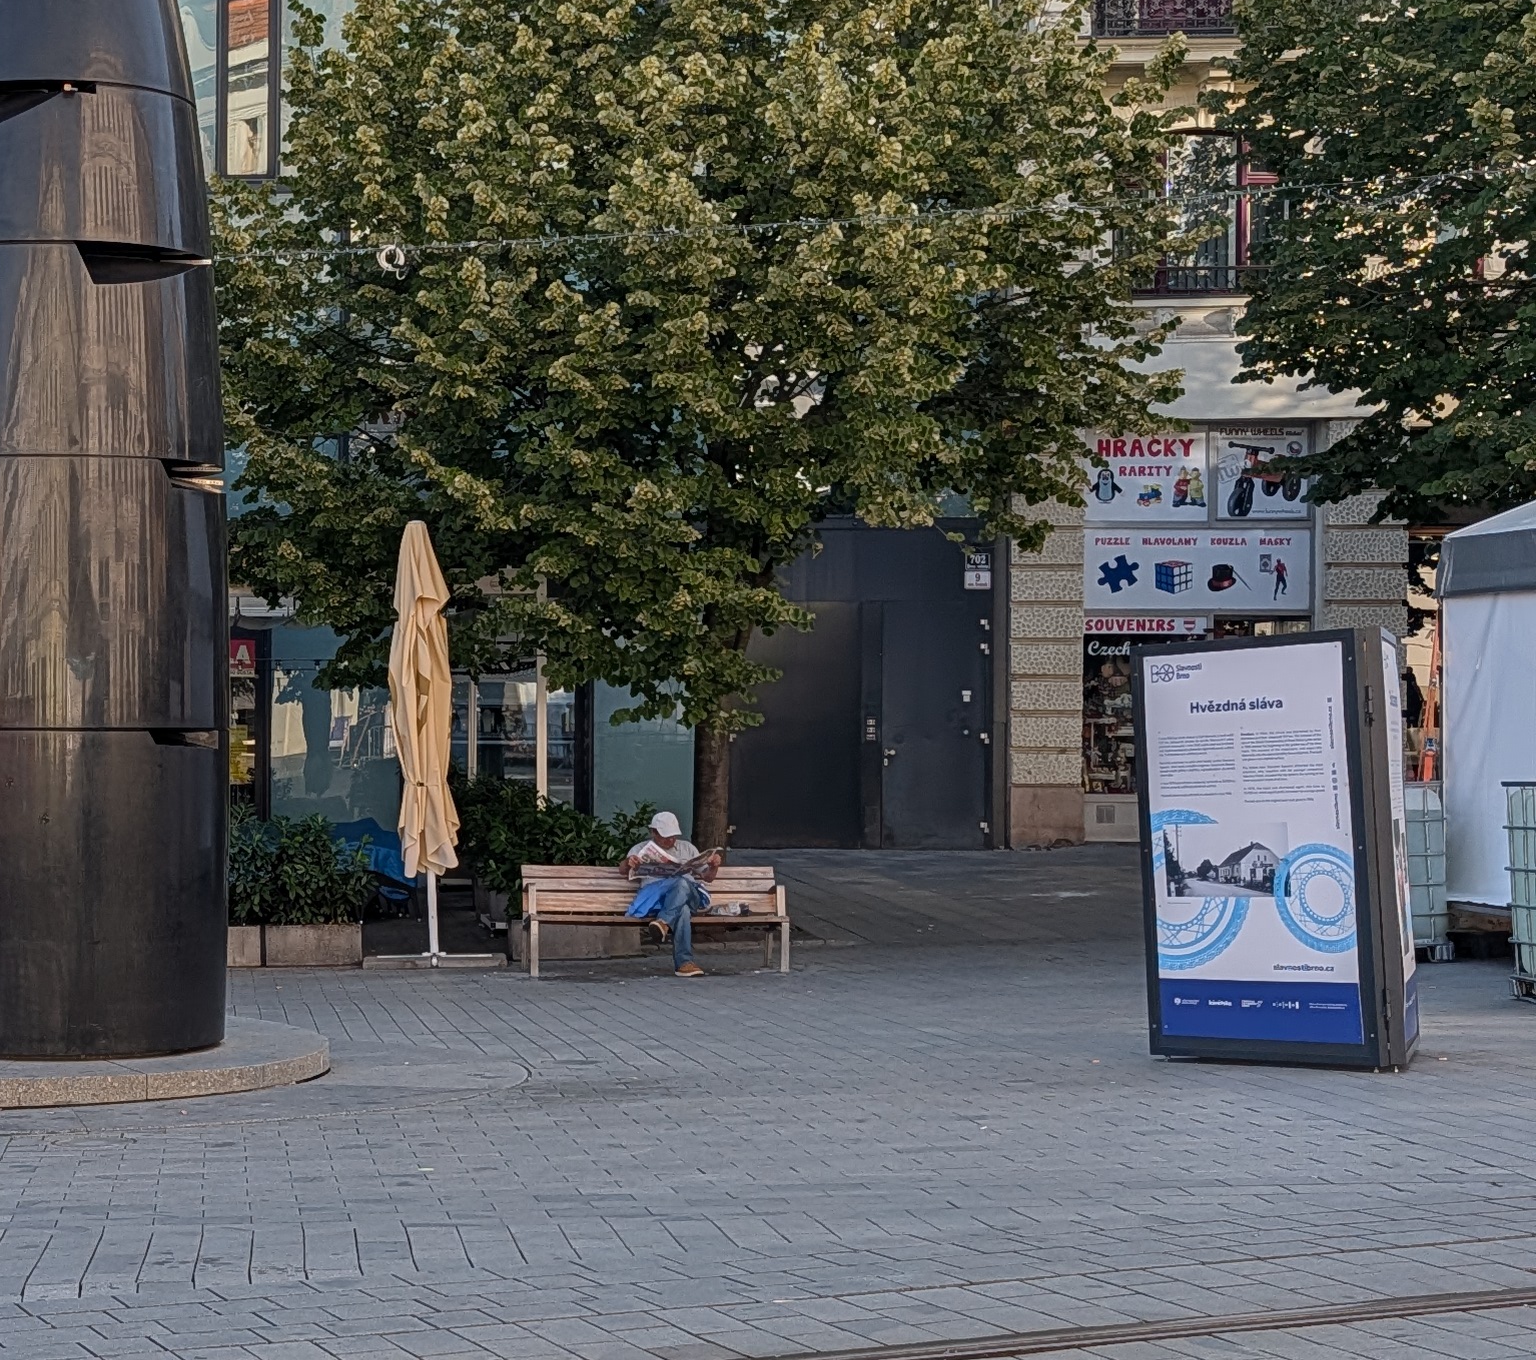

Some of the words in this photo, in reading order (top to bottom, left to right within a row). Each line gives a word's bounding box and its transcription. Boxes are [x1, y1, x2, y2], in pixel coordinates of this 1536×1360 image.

[1219, 428, 1249, 436] FUNNY
[1251, 428, 1284, 436] WHEELS
[1118, 465, 1173, 477] RARITY
[1094, 537, 1131, 546] PUZZLE
[1141, 536, 1198, 546] HLAVOLAMY
[1210, 536, 1247, 546] KOUZLA
[1259, 536, 1292, 546] MASKY
[969, 554, 987, 564] 702
[975, 572, 981, 582] 9
[1085, 618, 1176, 632] SOUVENIRS
[1087, 640, 1131, 656] Czech
[1175, 672, 1190, 681] Brno
[1189, 698, 1246, 714] Hvězdná
[1248, 696, 1283, 711] sláva
